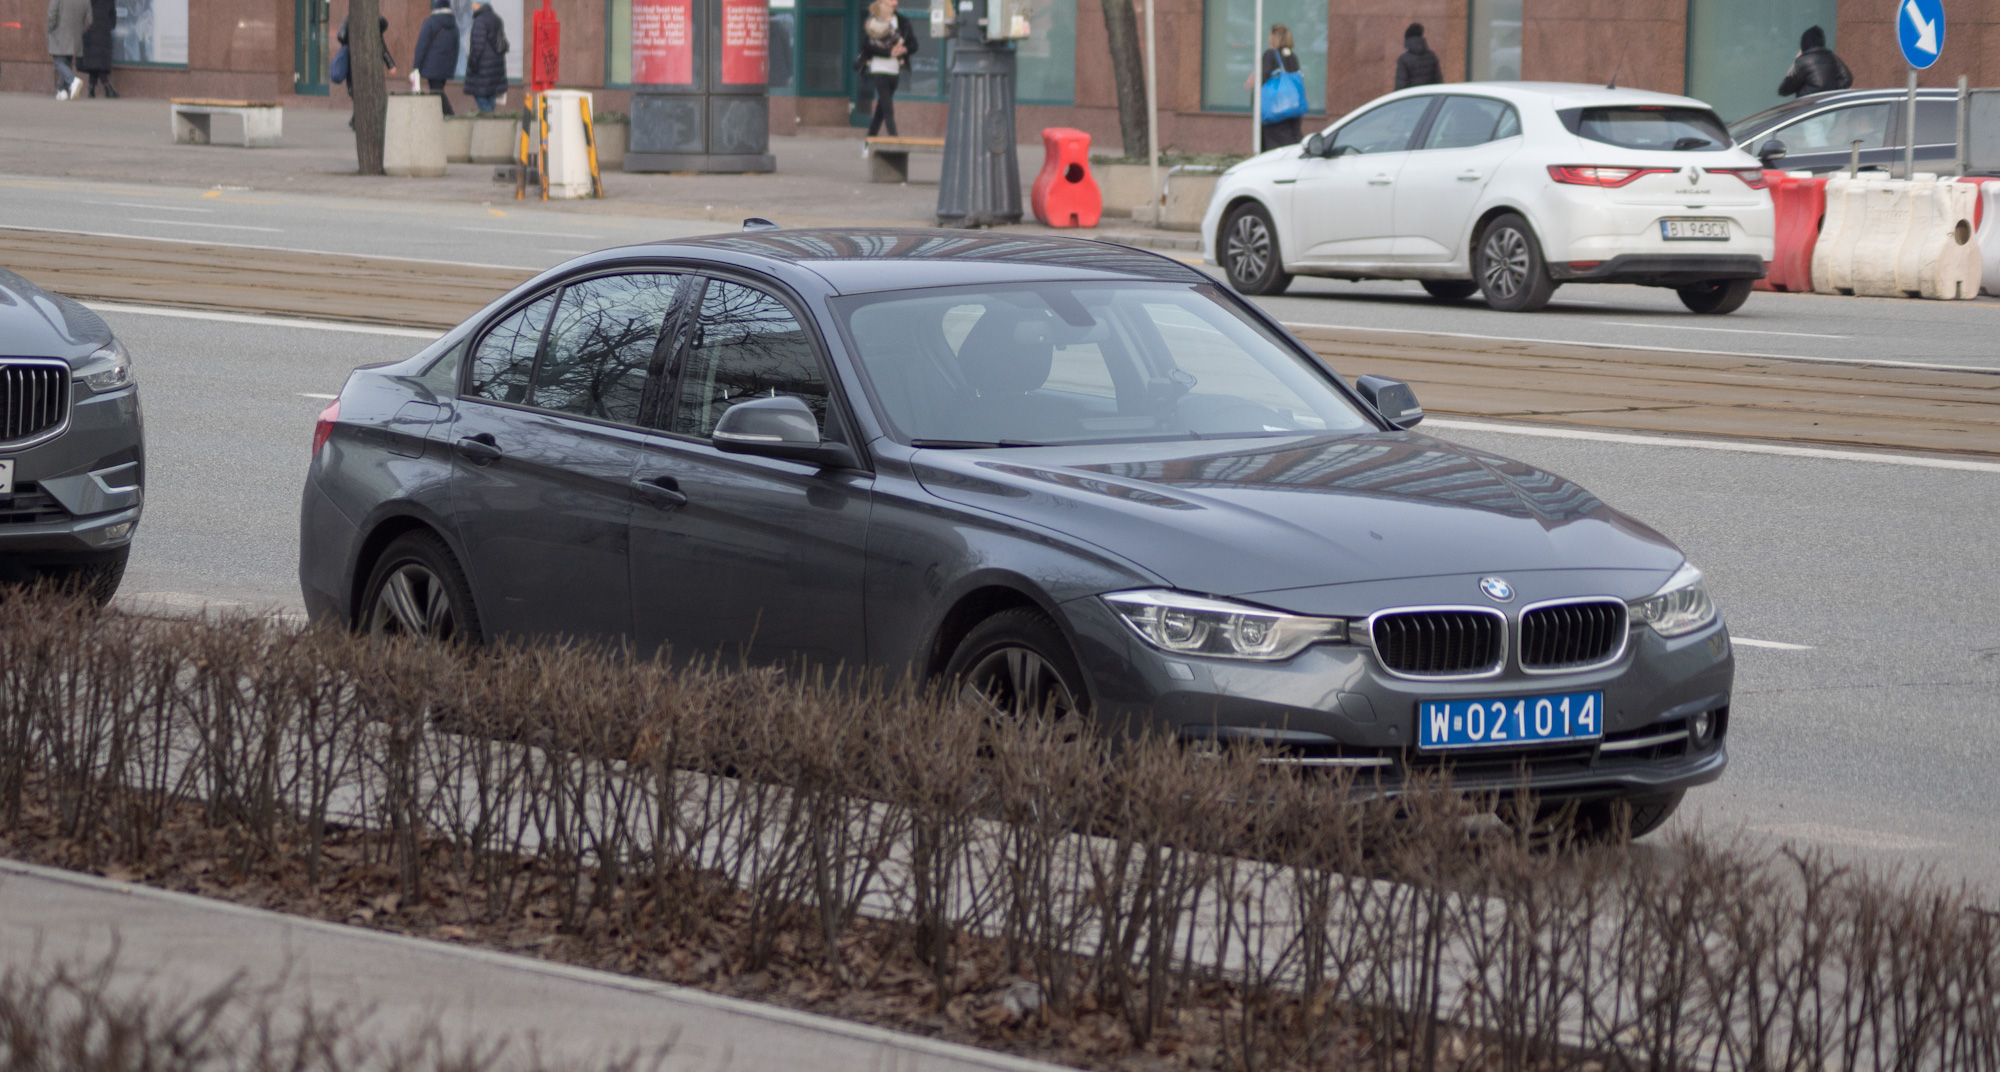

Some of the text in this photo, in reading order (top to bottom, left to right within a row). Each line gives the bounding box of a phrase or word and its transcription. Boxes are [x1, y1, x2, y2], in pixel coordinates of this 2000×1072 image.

[1671, 222, 1727, 237] BI 943CX
[1430, 694, 1595, 743] W 021014
